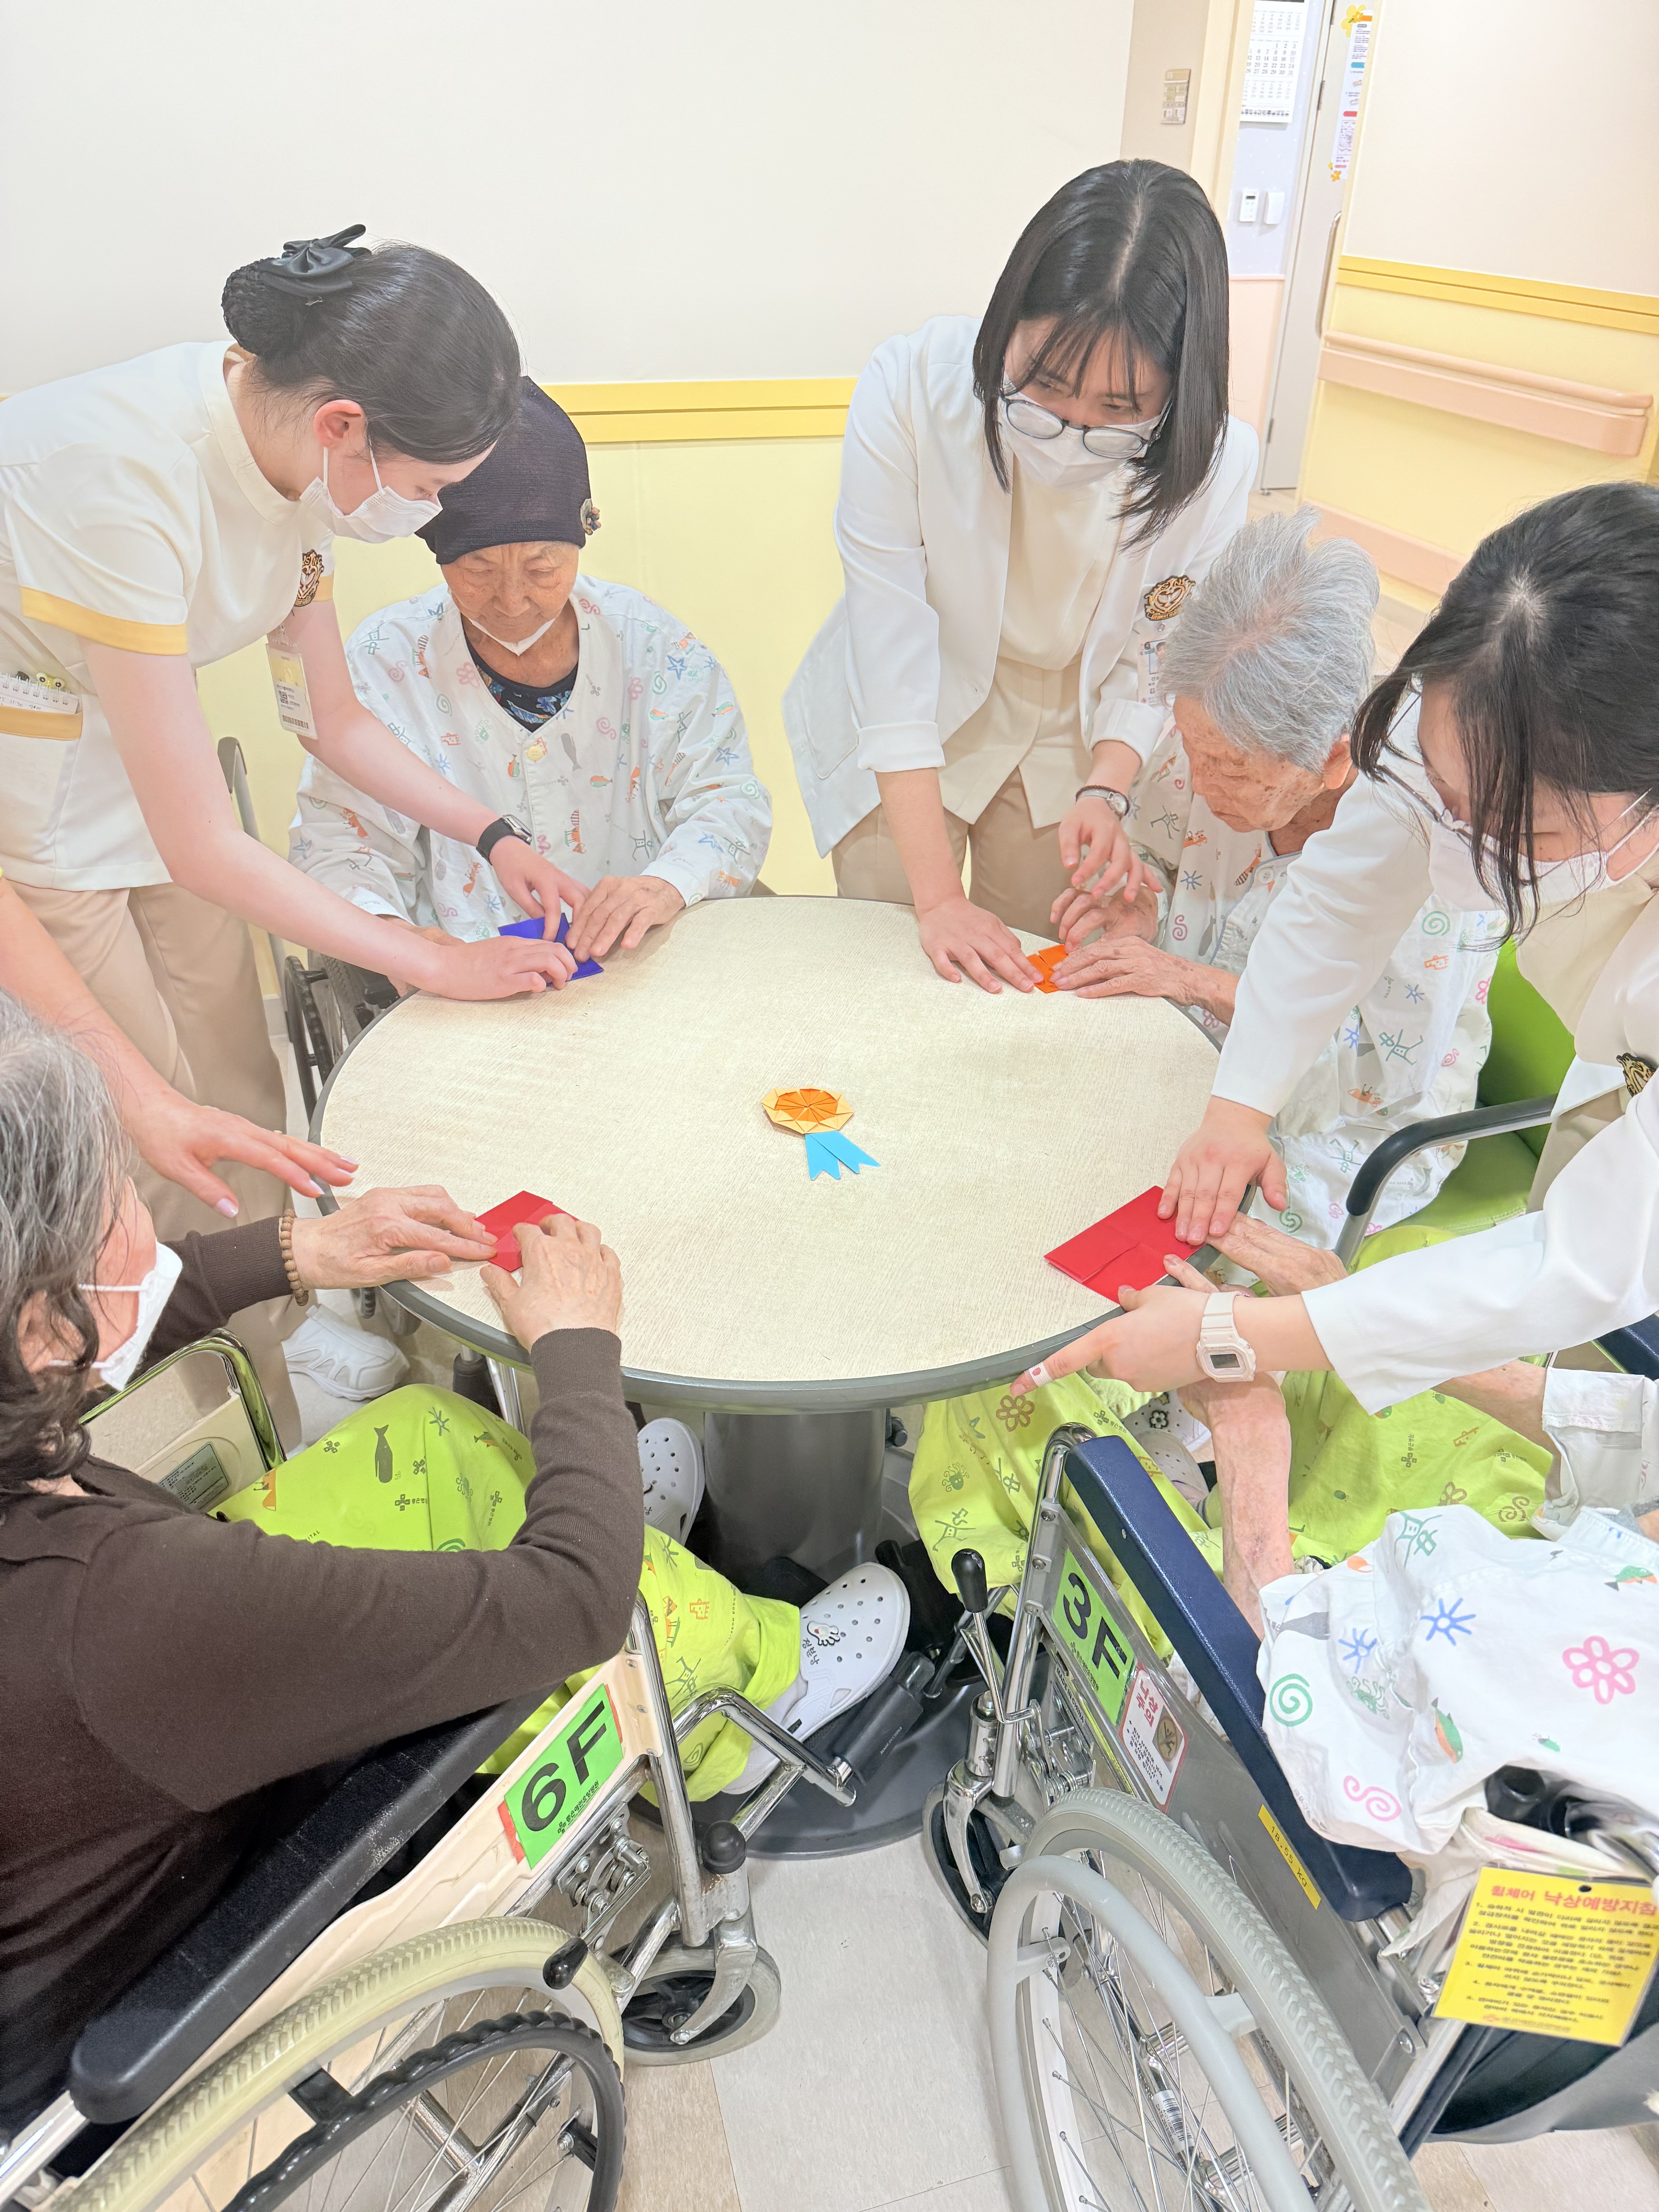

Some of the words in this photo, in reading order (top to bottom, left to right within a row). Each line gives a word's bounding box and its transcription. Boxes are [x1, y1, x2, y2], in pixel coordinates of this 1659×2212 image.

[1063, 1573, 1127, 1679] 3F
[1056, 1667, 1068, 1690] MADE
[1067, 1688, 1072, 1699] IN
[1072, 1698, 1086, 1723] CHINA
[1137, 1696, 1154, 1727] 주의
[1139, 1680, 1158, 1712] 낙상
[521, 1700, 607, 1831] 6F
[1270, 1826, 1294, 1864] 18.55
[1297, 1868, 1307, 1887] kg
[1491, 1886, 1535, 1900] 휠체어
[1544, 1891, 1656, 1915] 낙상예방지침
